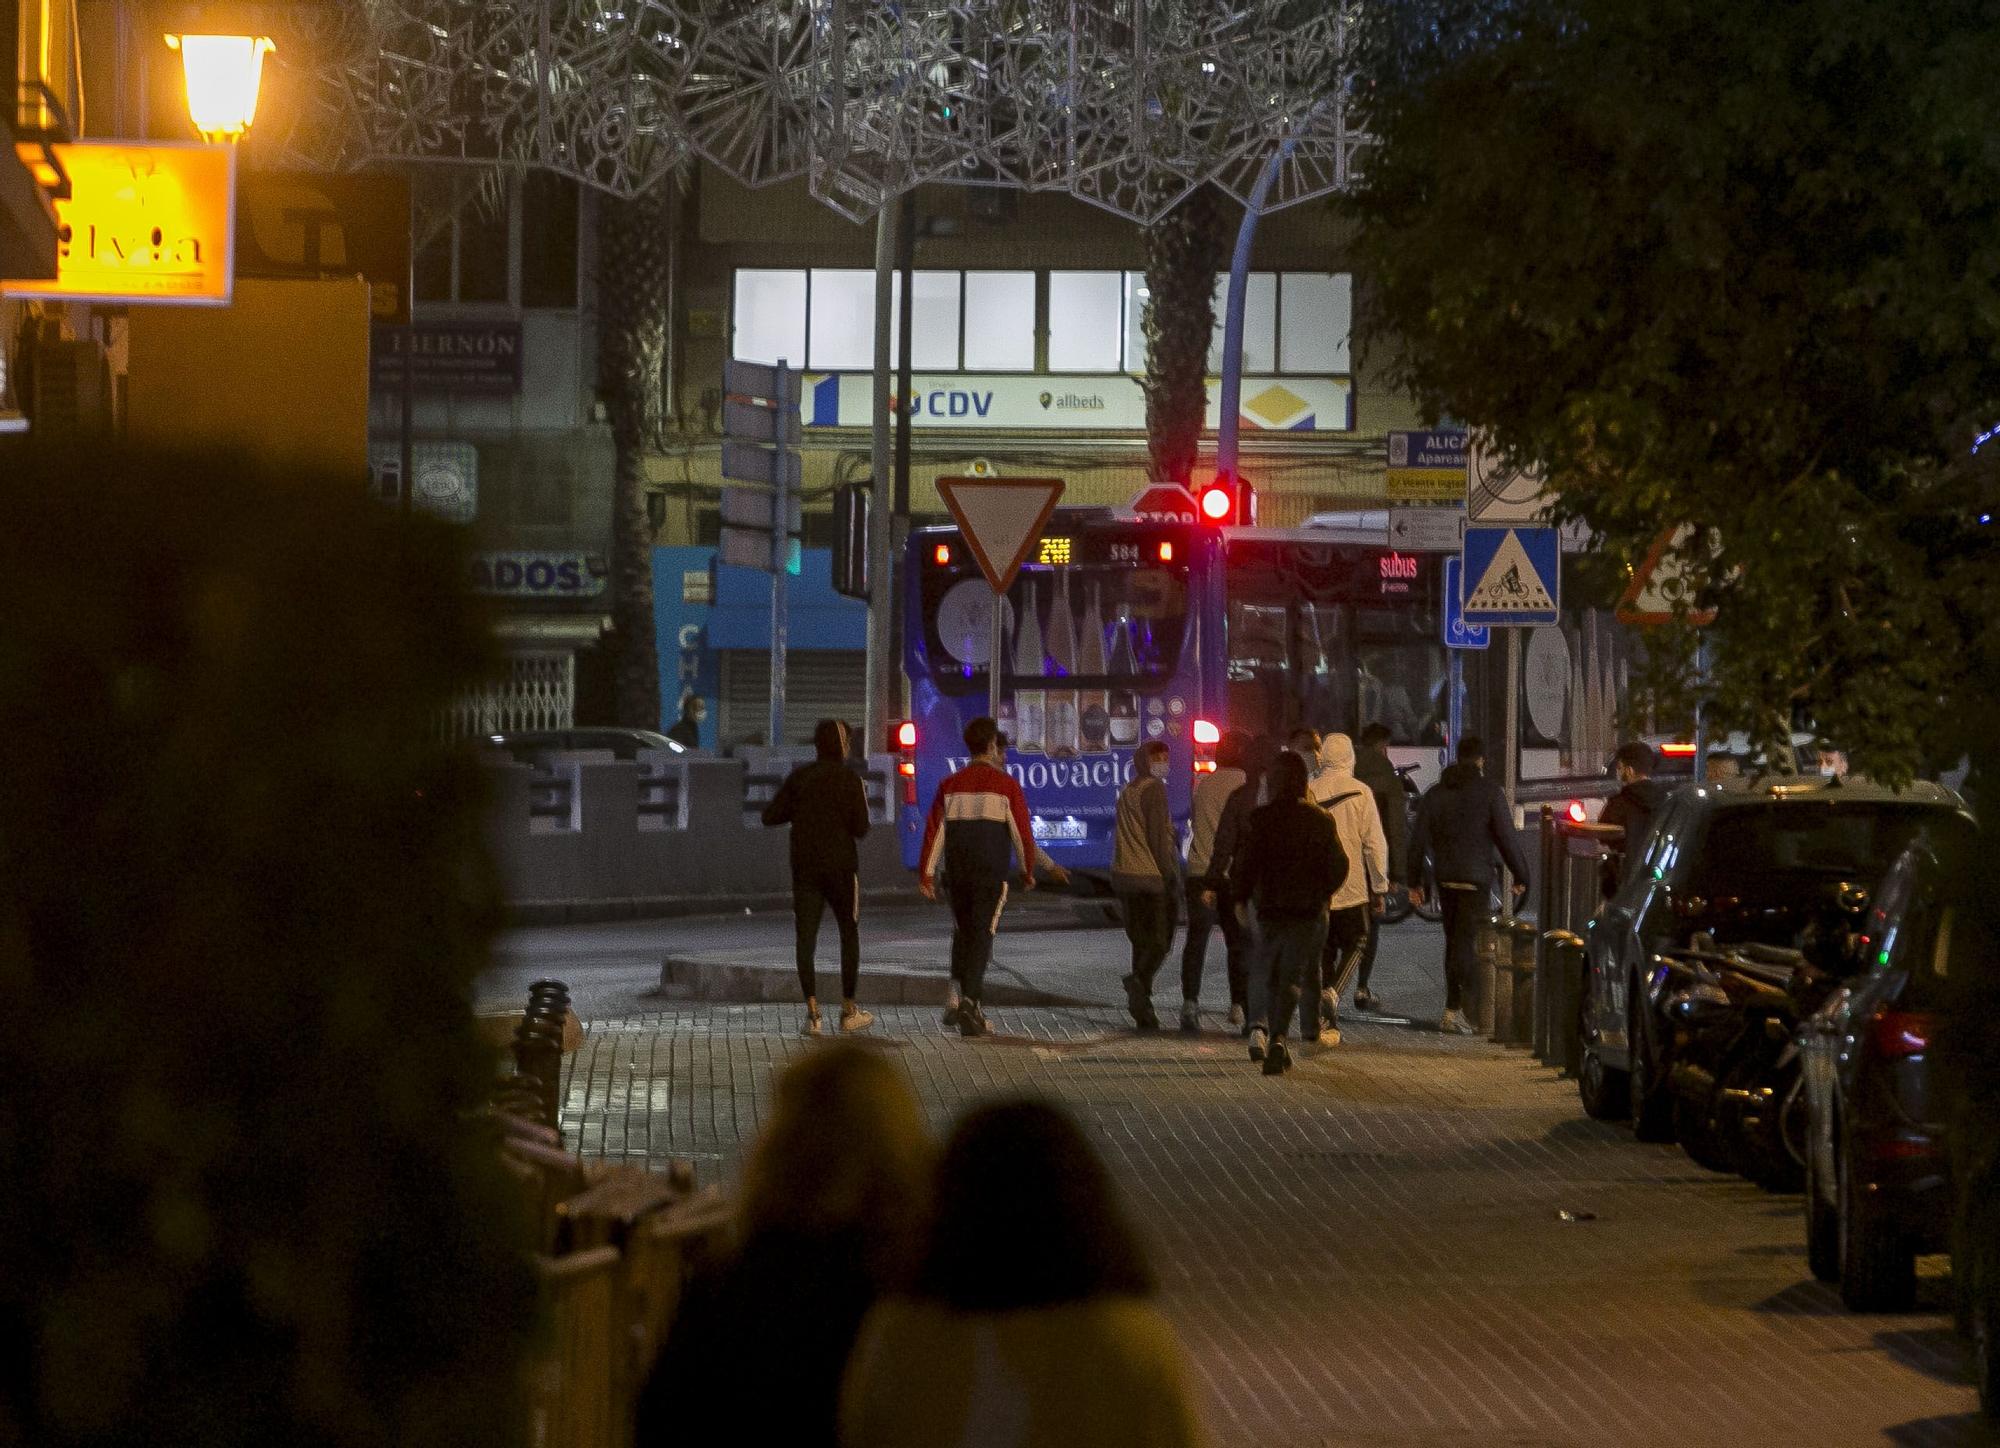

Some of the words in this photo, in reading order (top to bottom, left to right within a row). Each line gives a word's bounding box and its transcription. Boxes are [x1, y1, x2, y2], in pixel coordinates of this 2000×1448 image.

[928, 391, 993, 417] CDV
[1056, 393, 1105, 409] allbeds
[1380, 551, 1417, 578] subus
